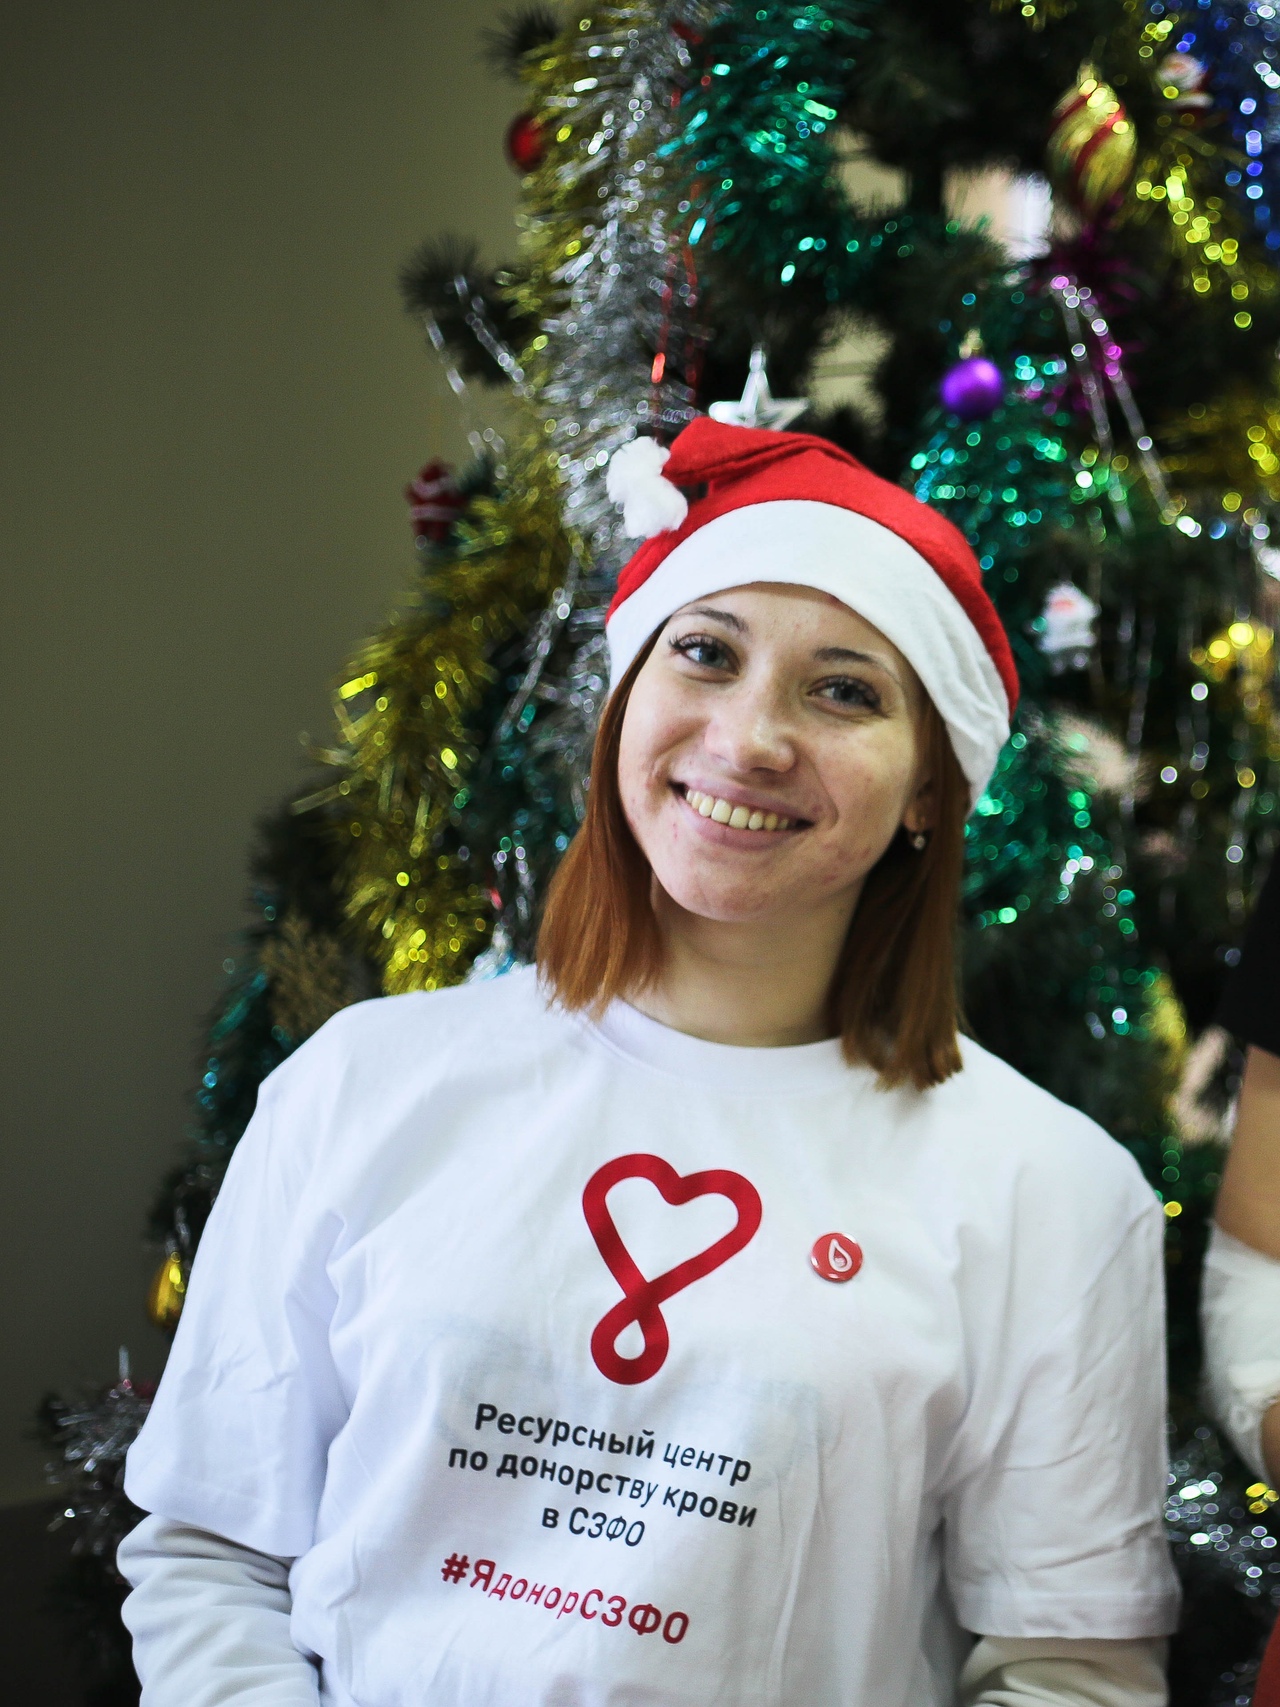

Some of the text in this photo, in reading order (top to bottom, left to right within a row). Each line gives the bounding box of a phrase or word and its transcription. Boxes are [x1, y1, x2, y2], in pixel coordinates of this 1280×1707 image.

[474, 1402, 752, 1486] Ресурсный центр
[448, 1448, 757, 1528] по донорству крови
[542, 1507, 646, 1547] в СЗФО
[440, 1552, 690, 1645] #ЯдонорСЗФО
